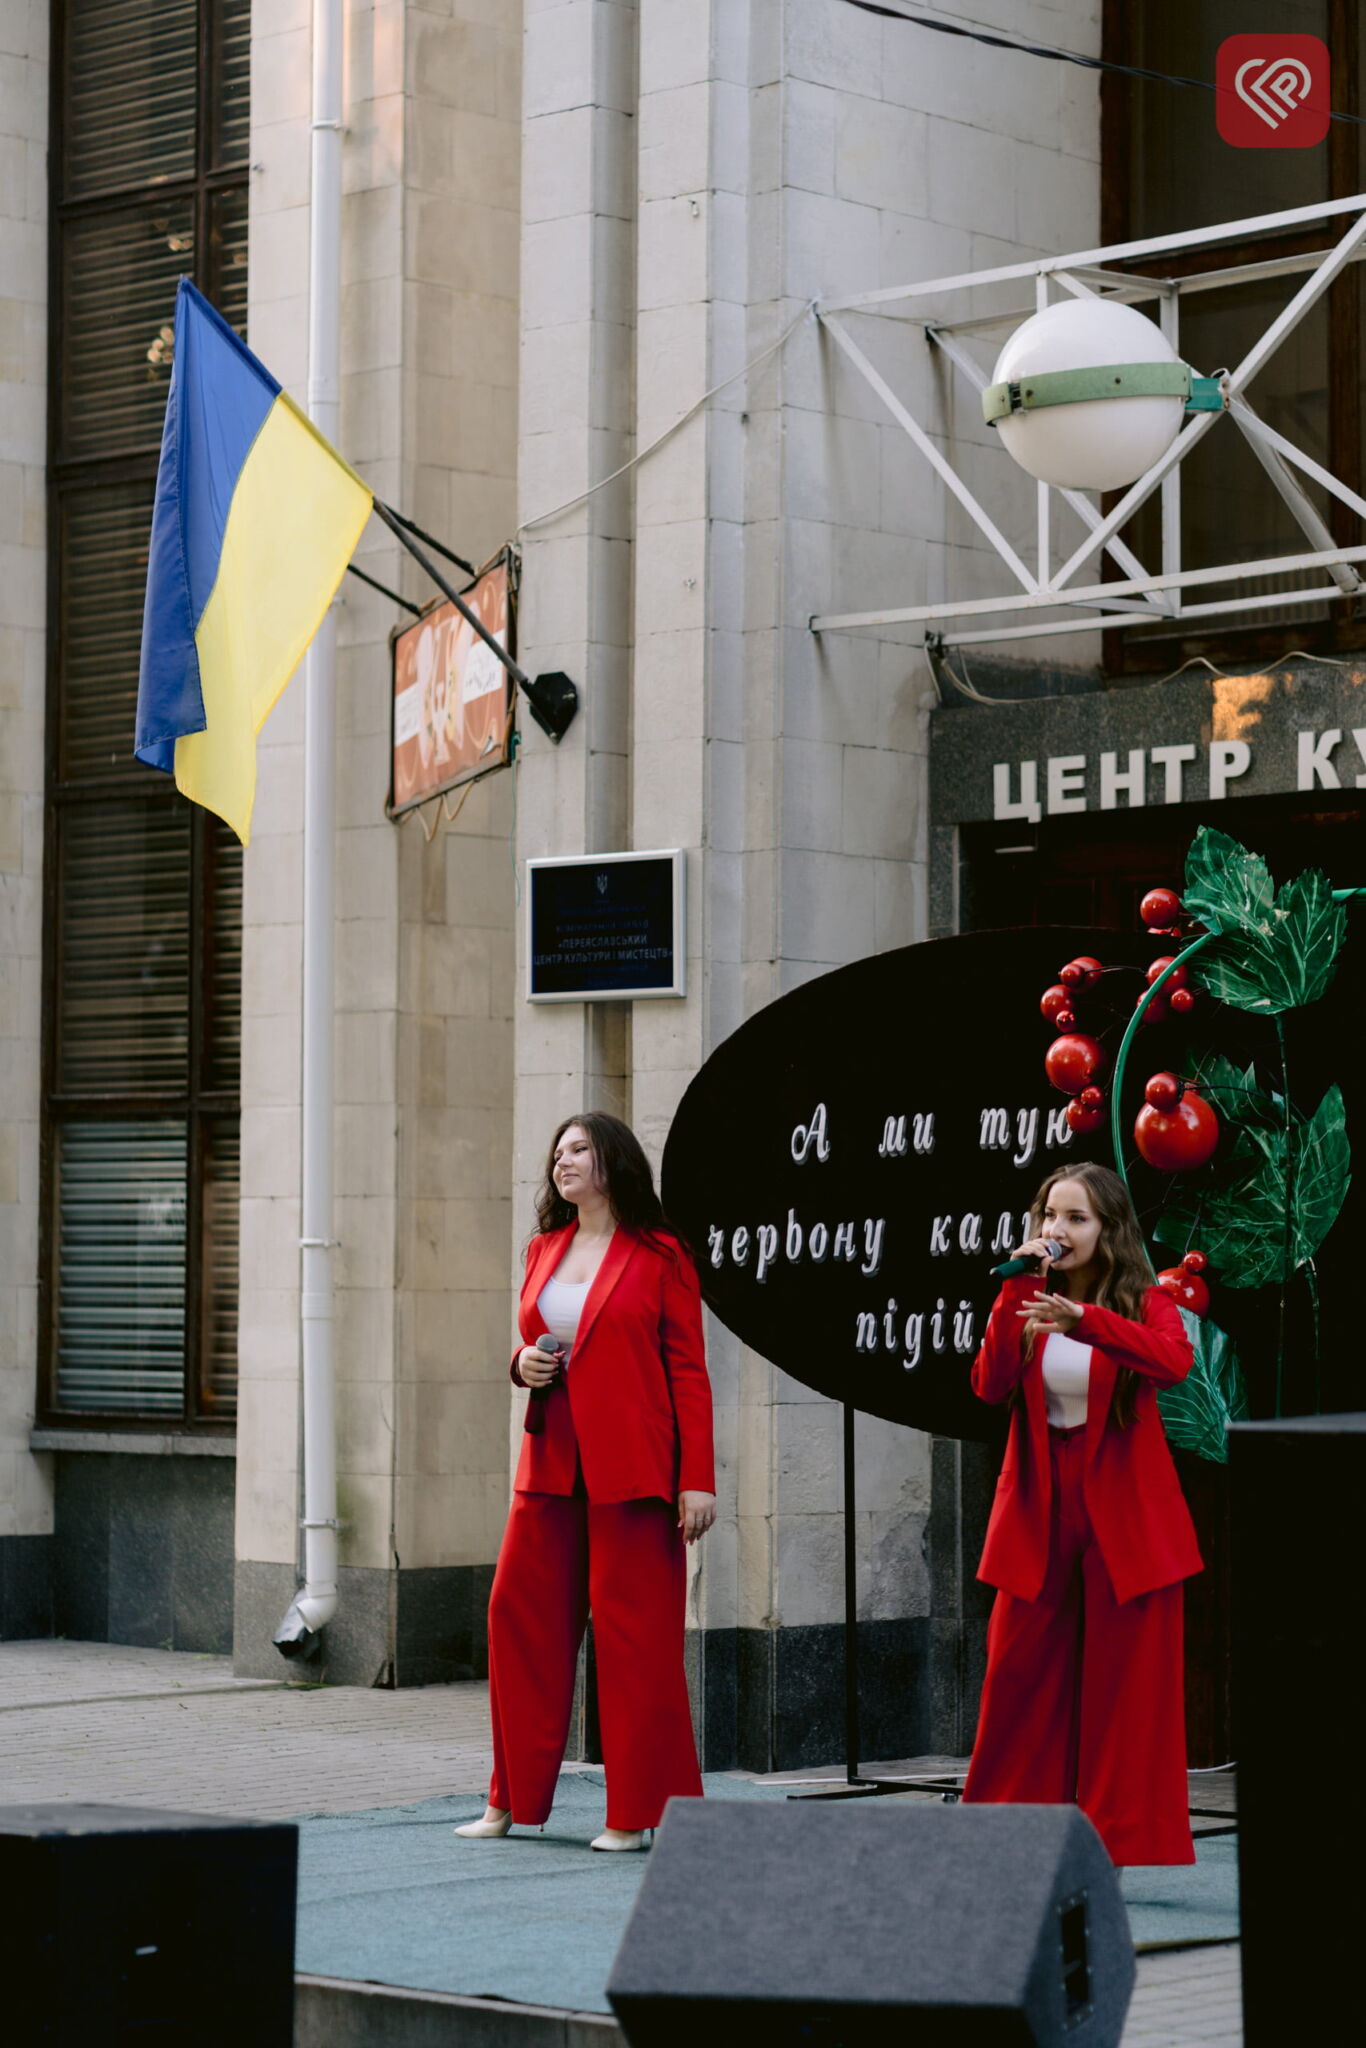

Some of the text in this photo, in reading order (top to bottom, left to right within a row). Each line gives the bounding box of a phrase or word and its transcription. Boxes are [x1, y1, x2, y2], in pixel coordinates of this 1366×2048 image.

[992, 740, 1252, 823] ЦЕНТР
[534, 953, 562, 966] ЦЕНТР
[790, 1102, 831, 1165] А
[878, 1112, 936, 1158] ми
[707, 1208, 887, 1283] червону
[855, 1297, 993, 1374] підій
